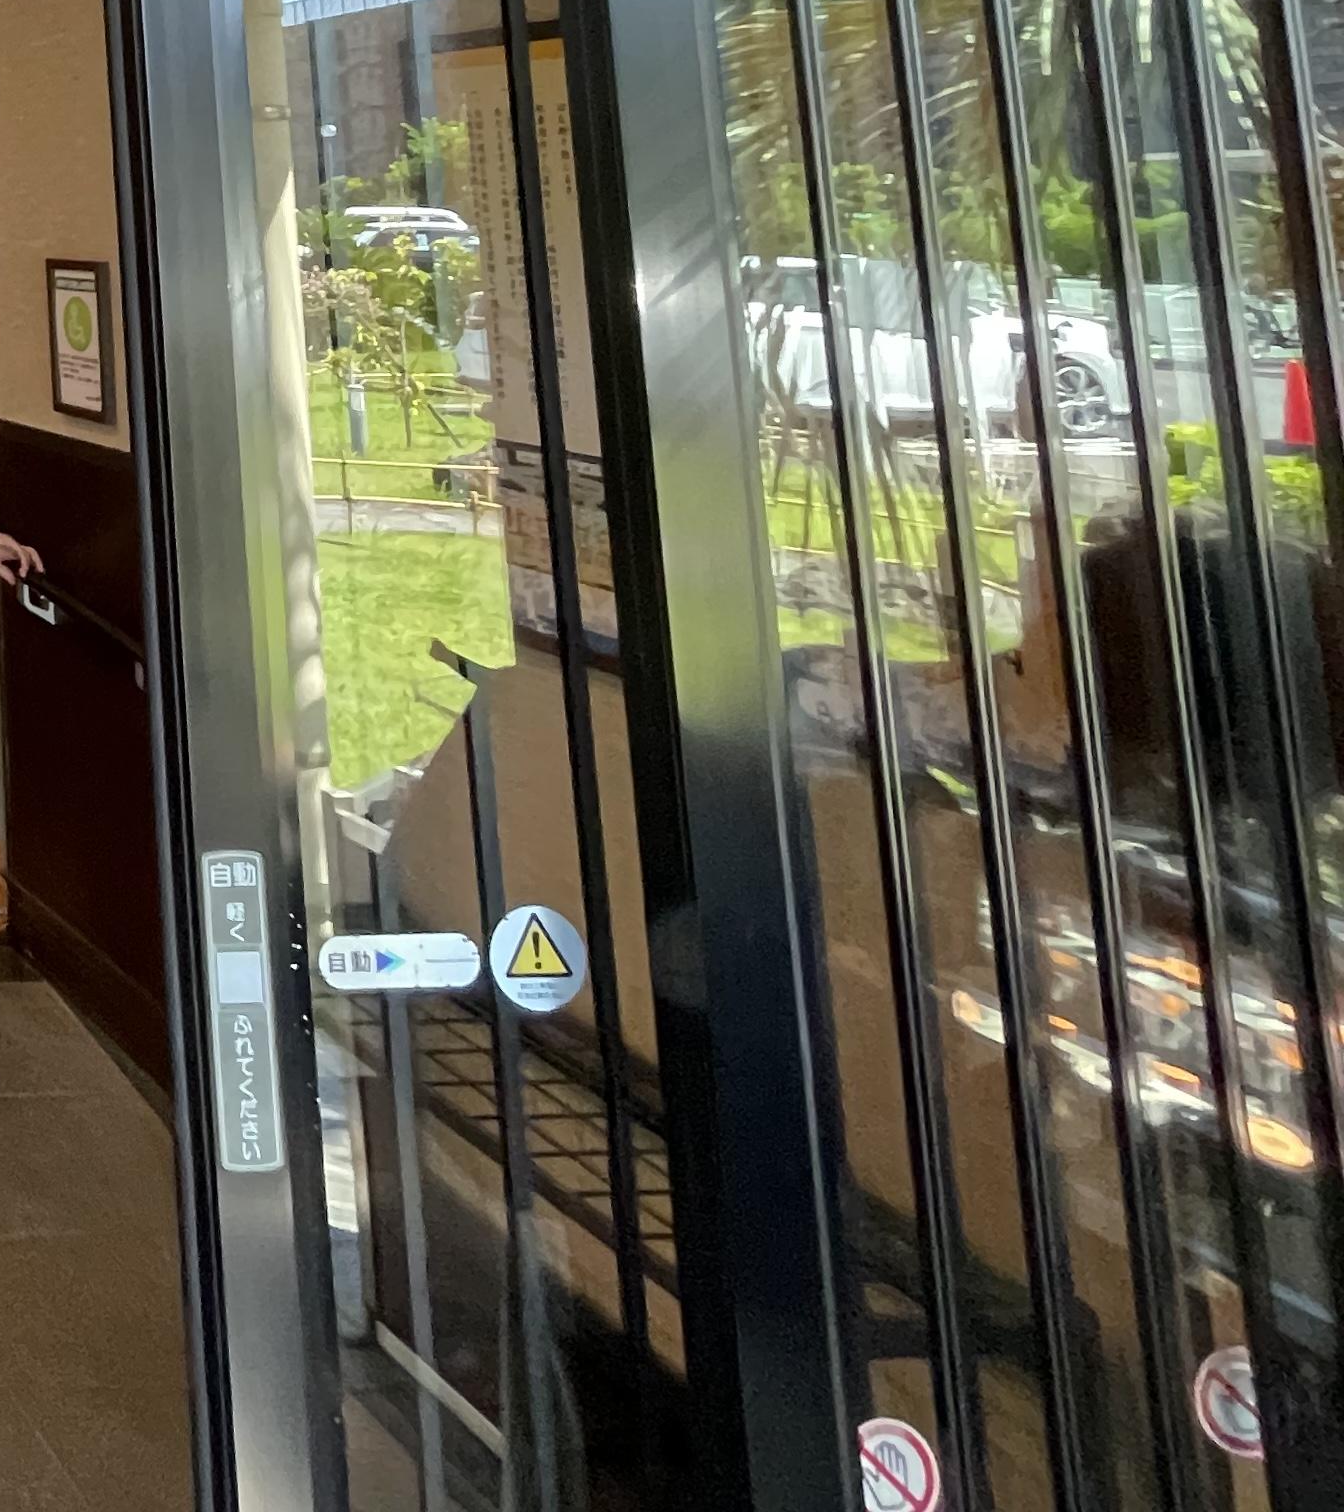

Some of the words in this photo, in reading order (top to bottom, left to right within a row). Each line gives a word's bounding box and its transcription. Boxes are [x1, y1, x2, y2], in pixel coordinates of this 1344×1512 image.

[209, 861, 257, 888] 自動
[328, 950, 372, 974] 自動
[232, 1013, 262, 1161] ふれてください
